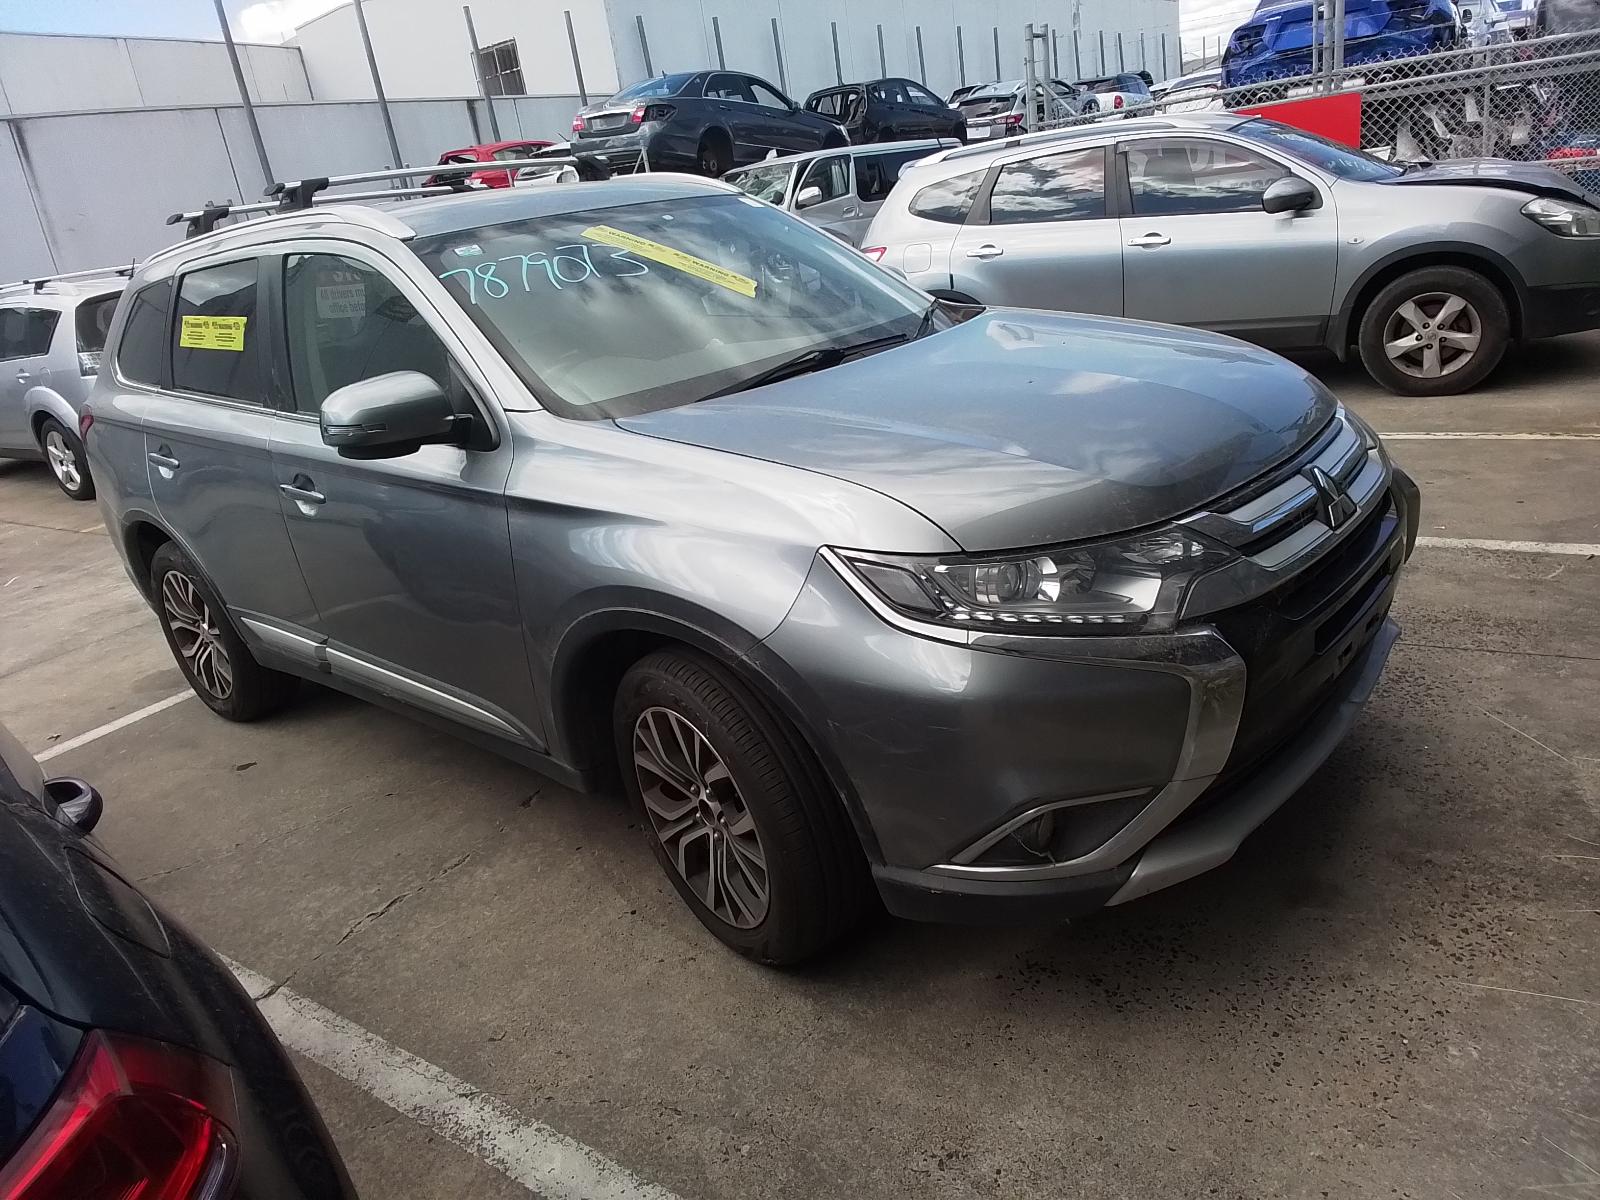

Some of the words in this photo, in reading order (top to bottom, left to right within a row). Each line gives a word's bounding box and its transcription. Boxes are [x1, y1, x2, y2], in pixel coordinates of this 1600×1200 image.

[607, 231, 647, 246] WARNING
[438, 244, 649, 304] 7879073
[692, 260, 730, 277] WARNING
